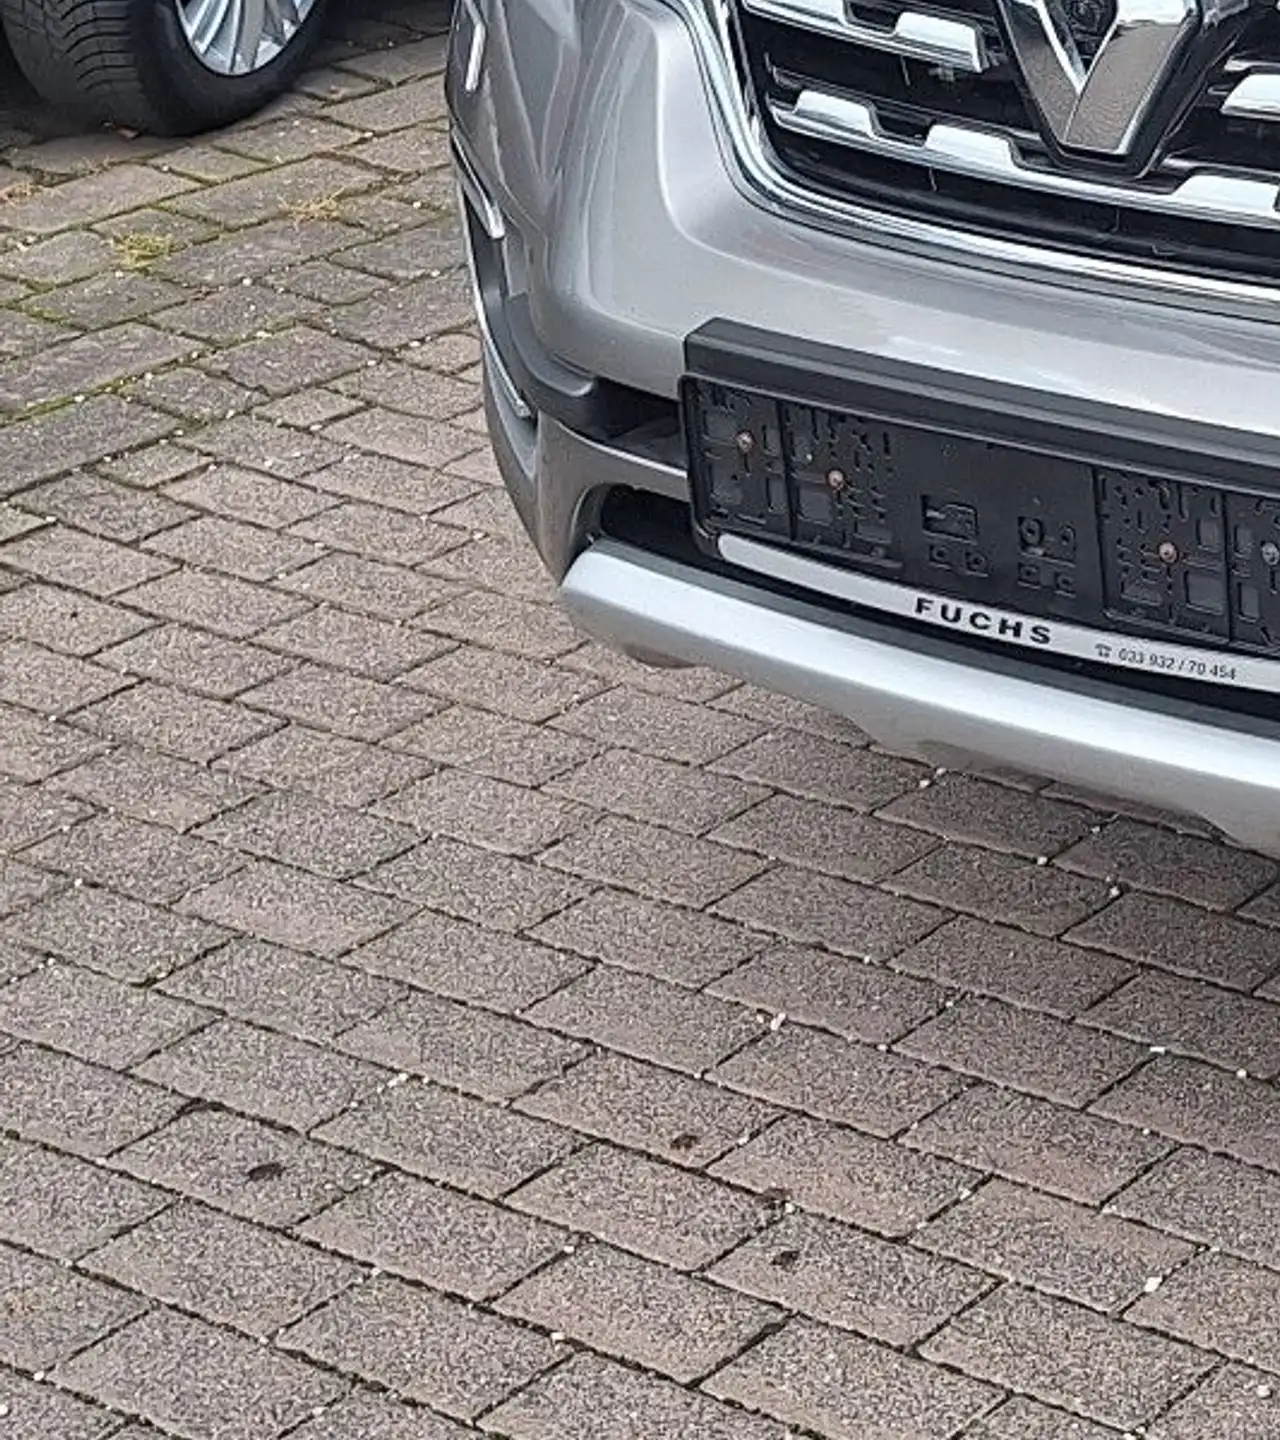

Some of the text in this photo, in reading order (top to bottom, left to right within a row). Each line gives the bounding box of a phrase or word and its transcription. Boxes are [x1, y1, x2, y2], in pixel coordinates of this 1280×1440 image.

[914, 597, 1051, 645] FUCHS
[1118, 647, 1145, 664] 033
[1149, 653, 1175, 670] 932
[1189, 660, 1206, 675] 70
[1209, 665, 1237, 680] 454
